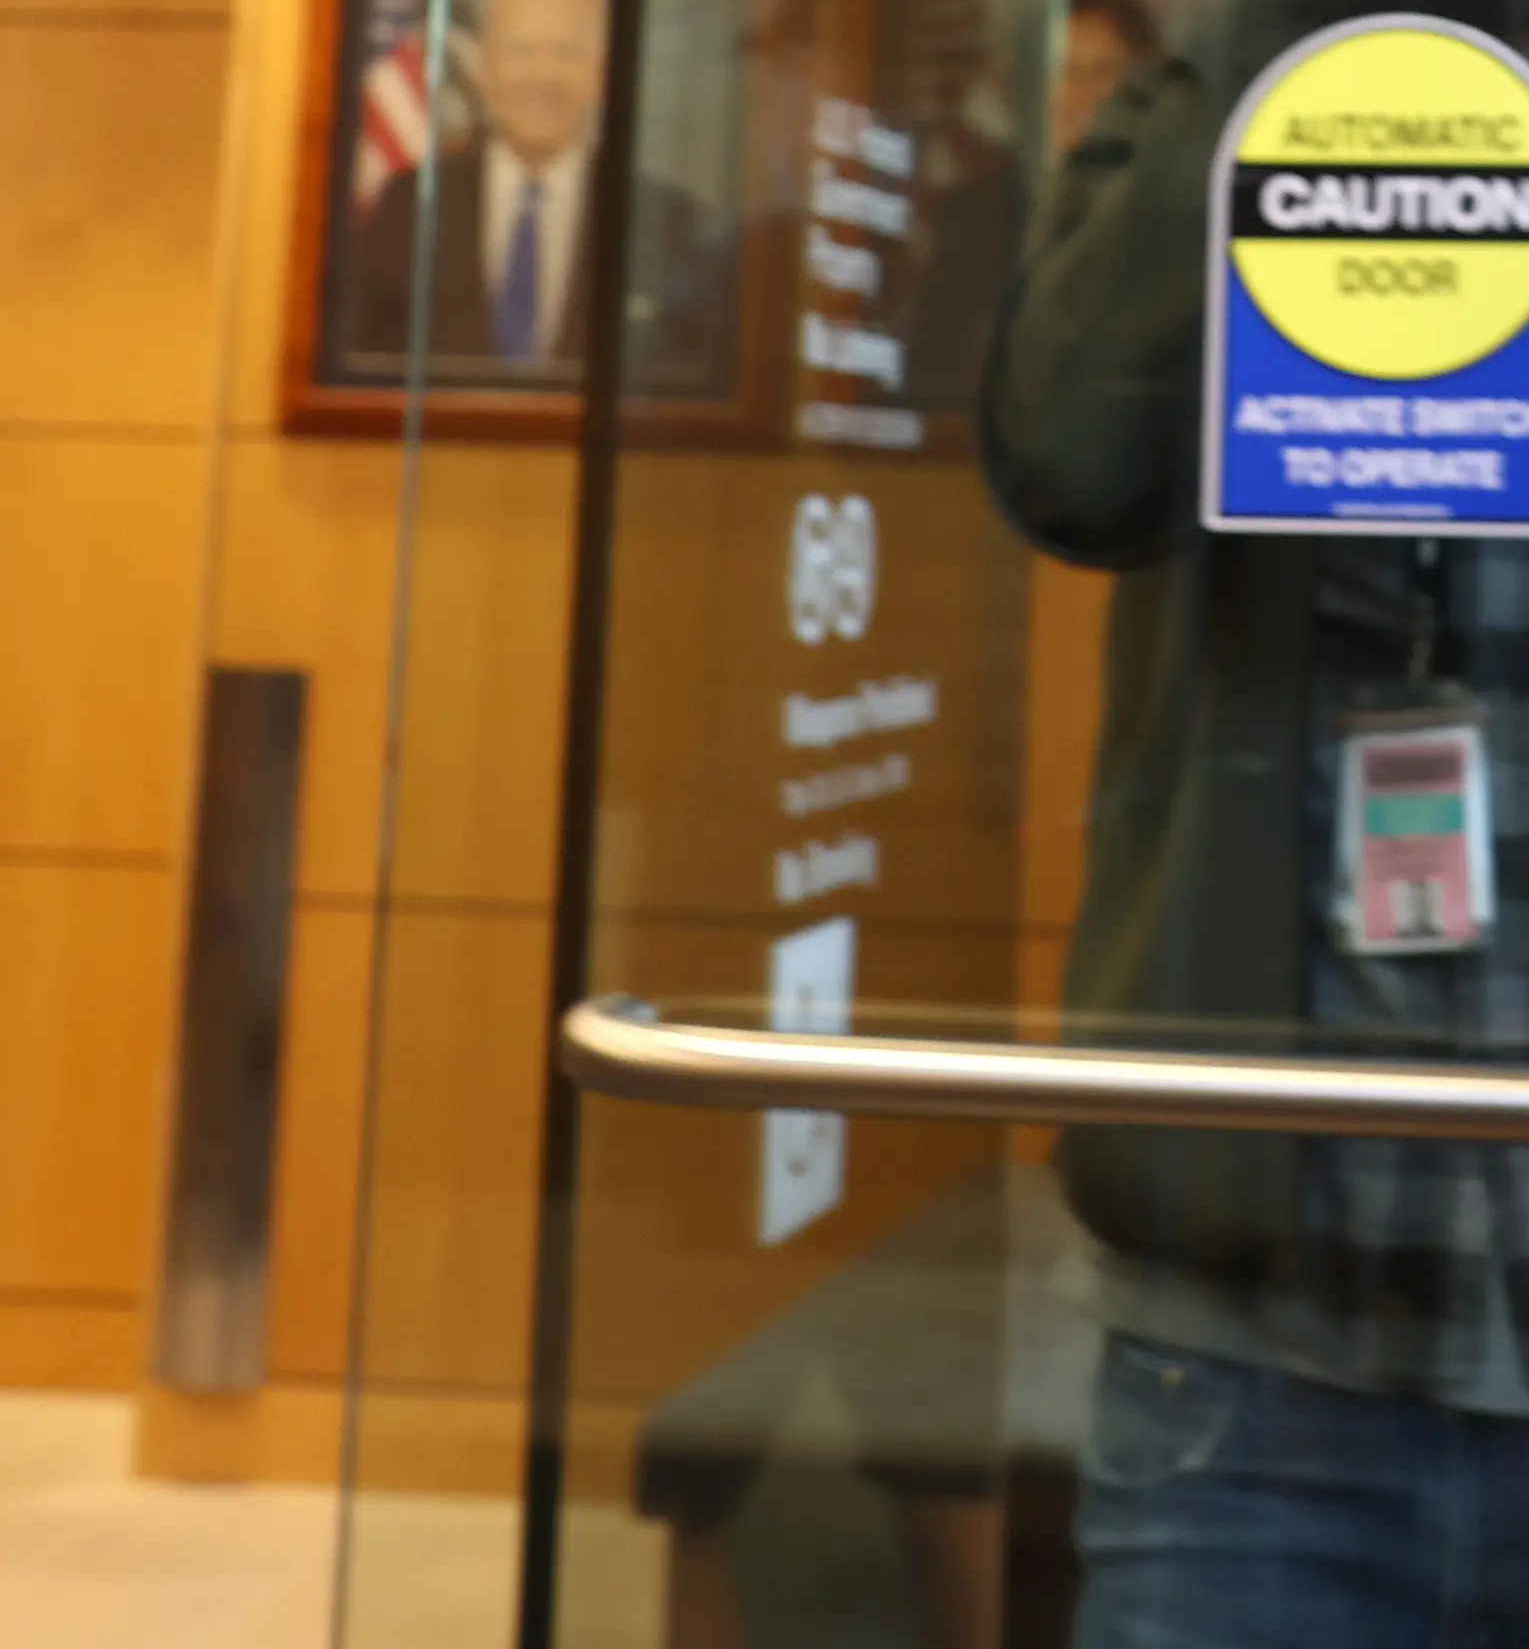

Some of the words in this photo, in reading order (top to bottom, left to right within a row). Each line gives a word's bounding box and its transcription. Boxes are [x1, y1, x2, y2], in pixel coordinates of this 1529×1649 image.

[1282, 114, 1523, 150] AUTOMATIC
[1337, 258, 1458, 295] DOOR
[1236, 395, 1403, 435] ACTIVATE
[1282, 446, 1333, 485] TO
[1341, 448, 1505, 490] OPERATE
